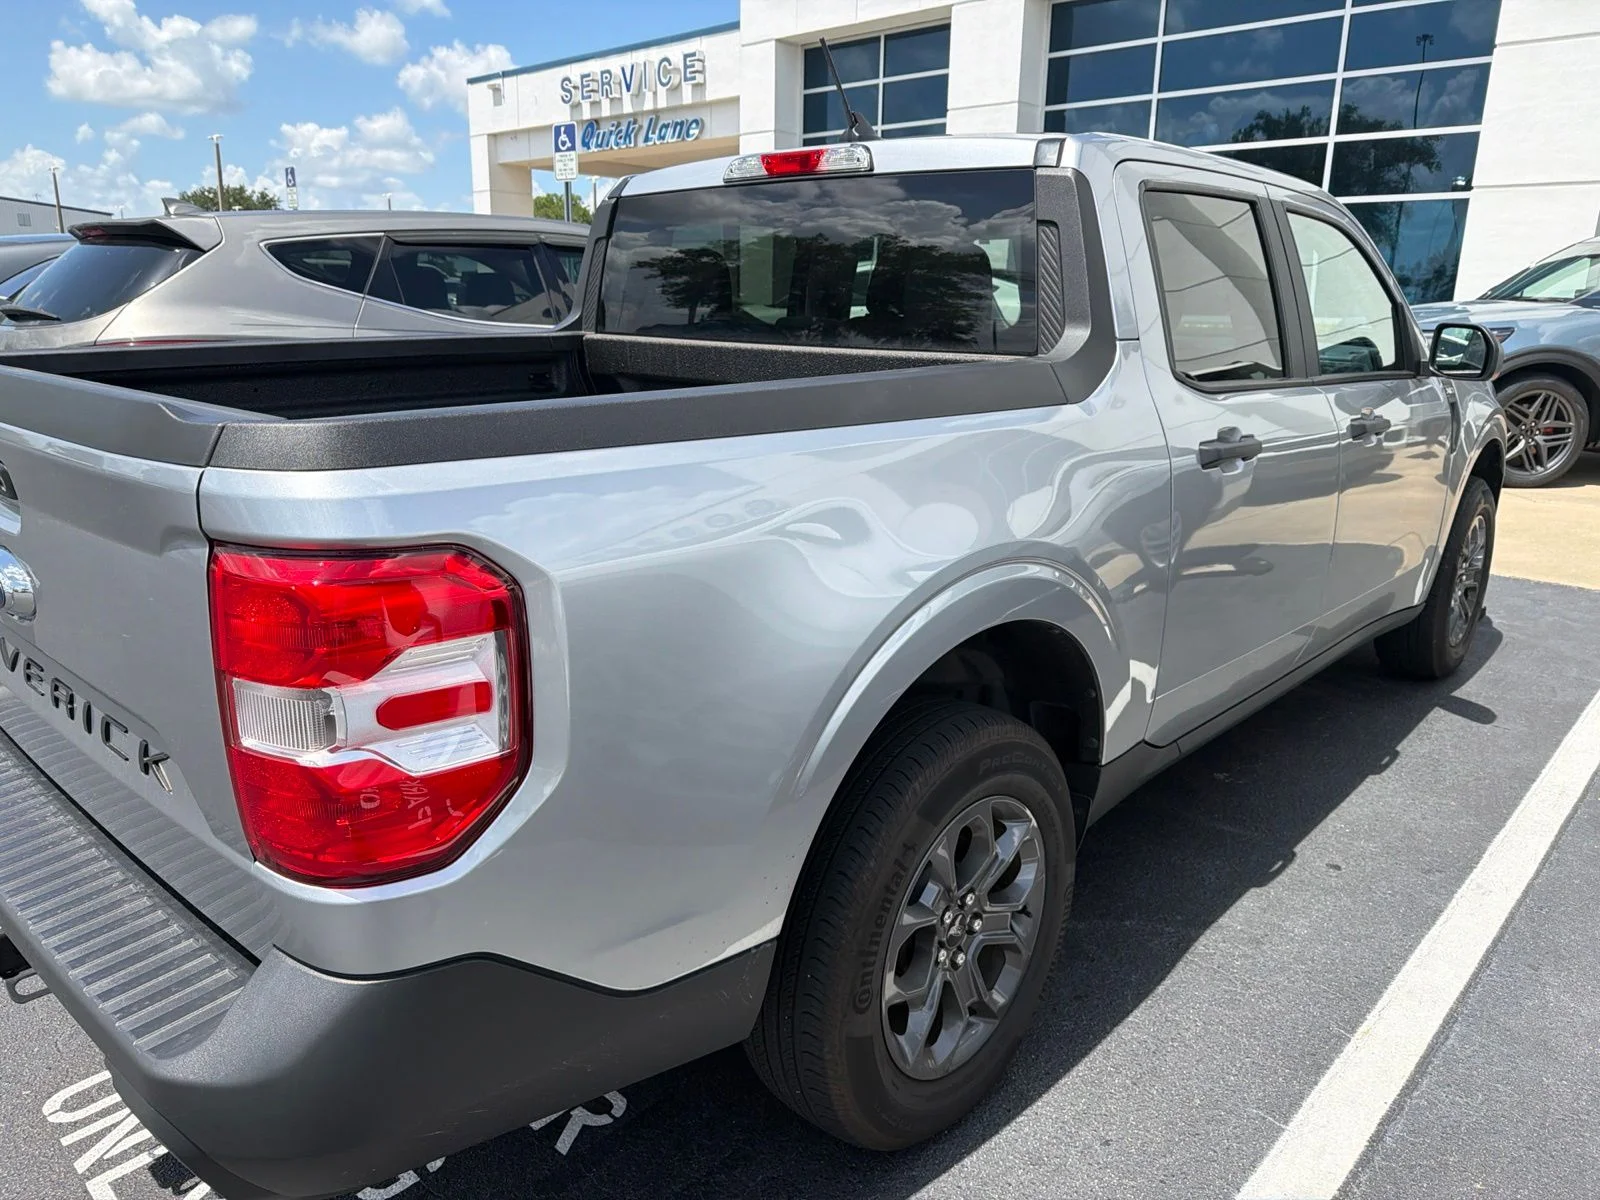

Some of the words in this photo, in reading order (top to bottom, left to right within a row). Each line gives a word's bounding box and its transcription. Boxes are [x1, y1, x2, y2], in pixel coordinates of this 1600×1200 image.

[561, 51, 704, 104] SERVICE
[581, 120, 638, 150] Quick
[643, 116, 701, 145] Lane
